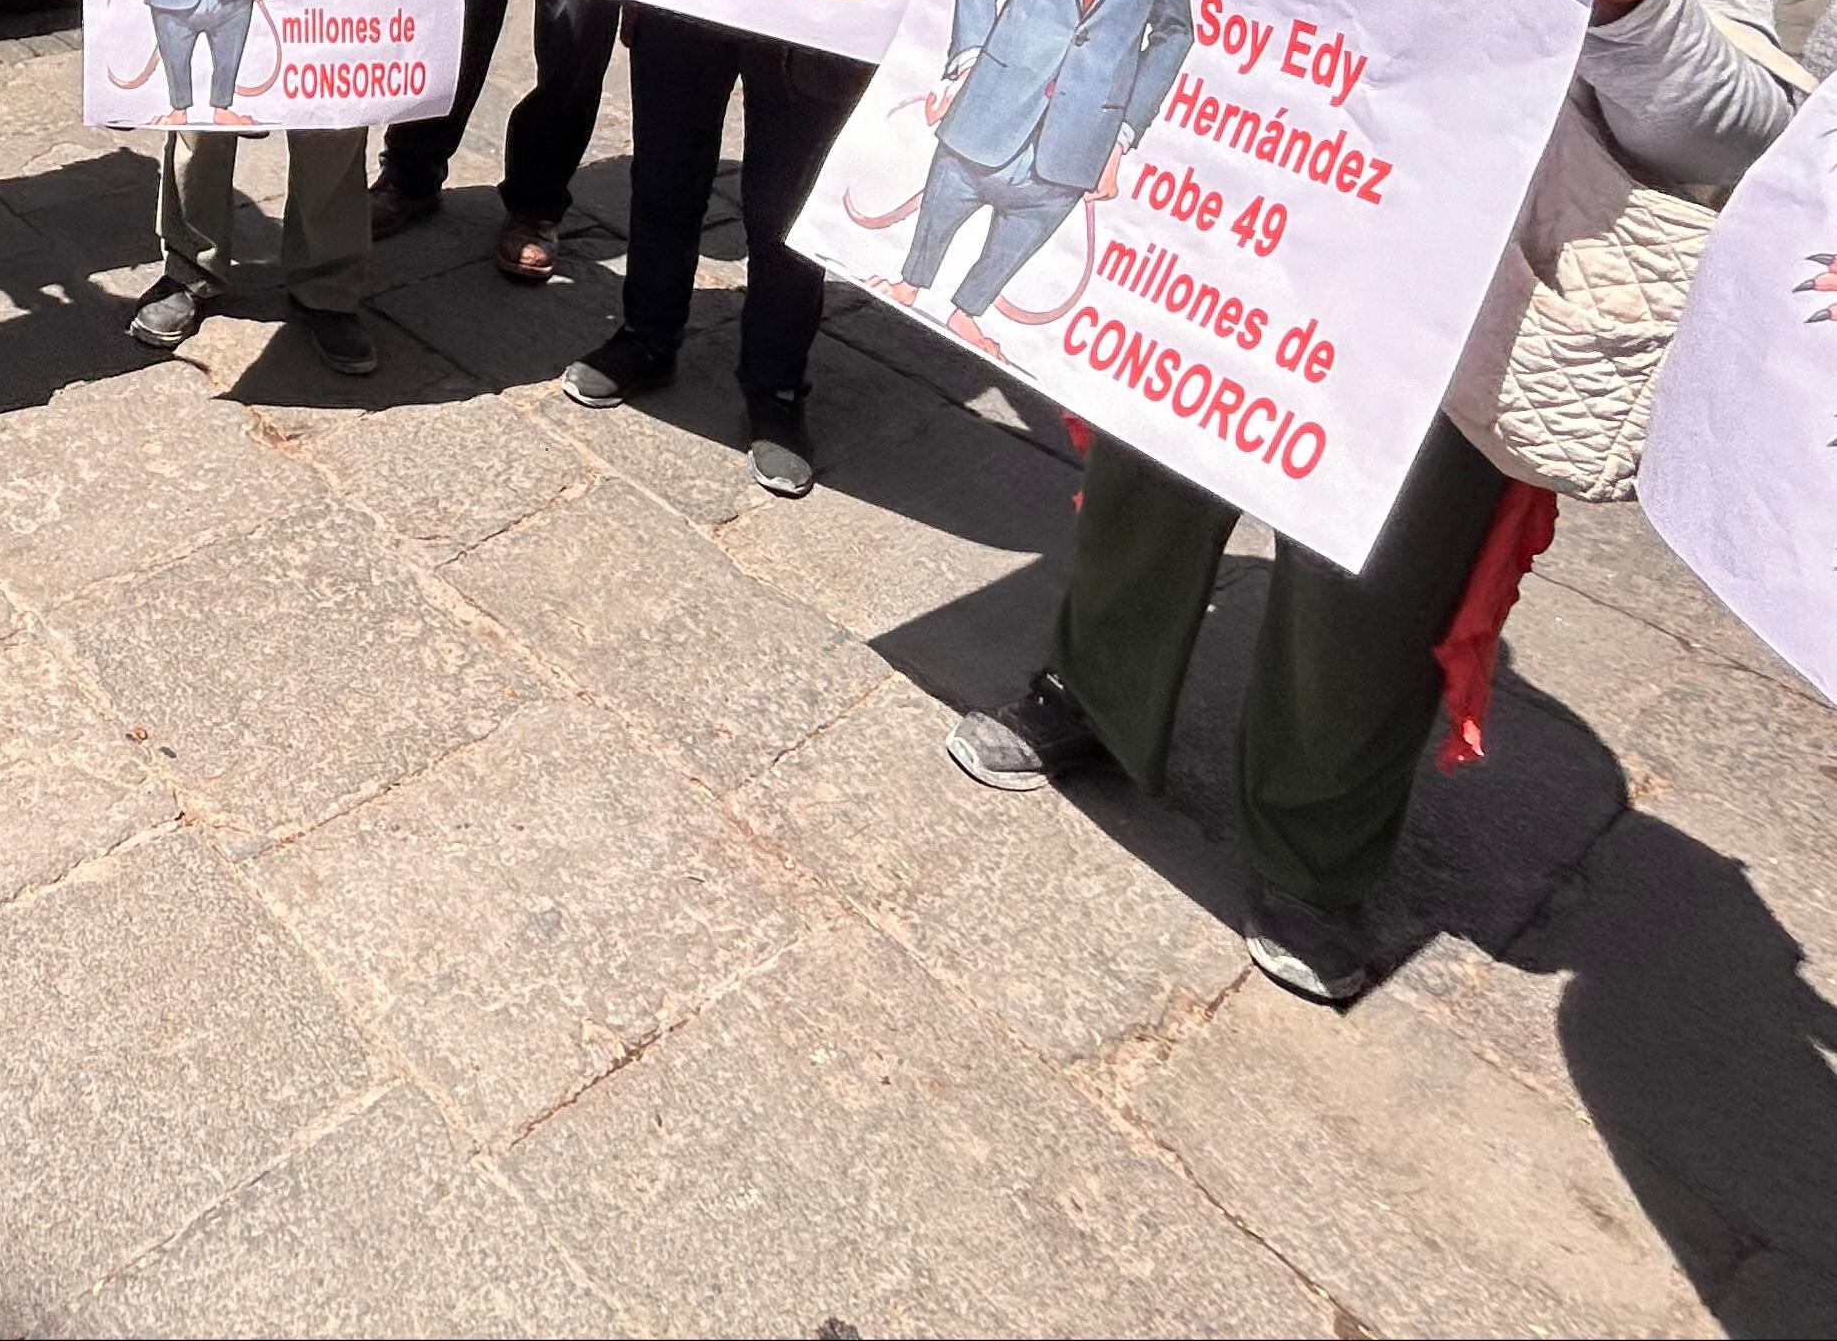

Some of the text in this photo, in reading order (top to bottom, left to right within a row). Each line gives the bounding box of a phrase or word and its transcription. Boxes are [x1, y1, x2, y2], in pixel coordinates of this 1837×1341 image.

[282, 8, 415, 44] millones de
[1280, 18, 1369, 108] Edy
[283, 61, 426, 100] CONSORCIO
[1164, 72, 1394, 205] Hernández
[1130, 162, 1289, 258] robe 49
[1096, 239, 1336, 384] millones de
[1063, 305, 1327, 481] CONSORCIO
